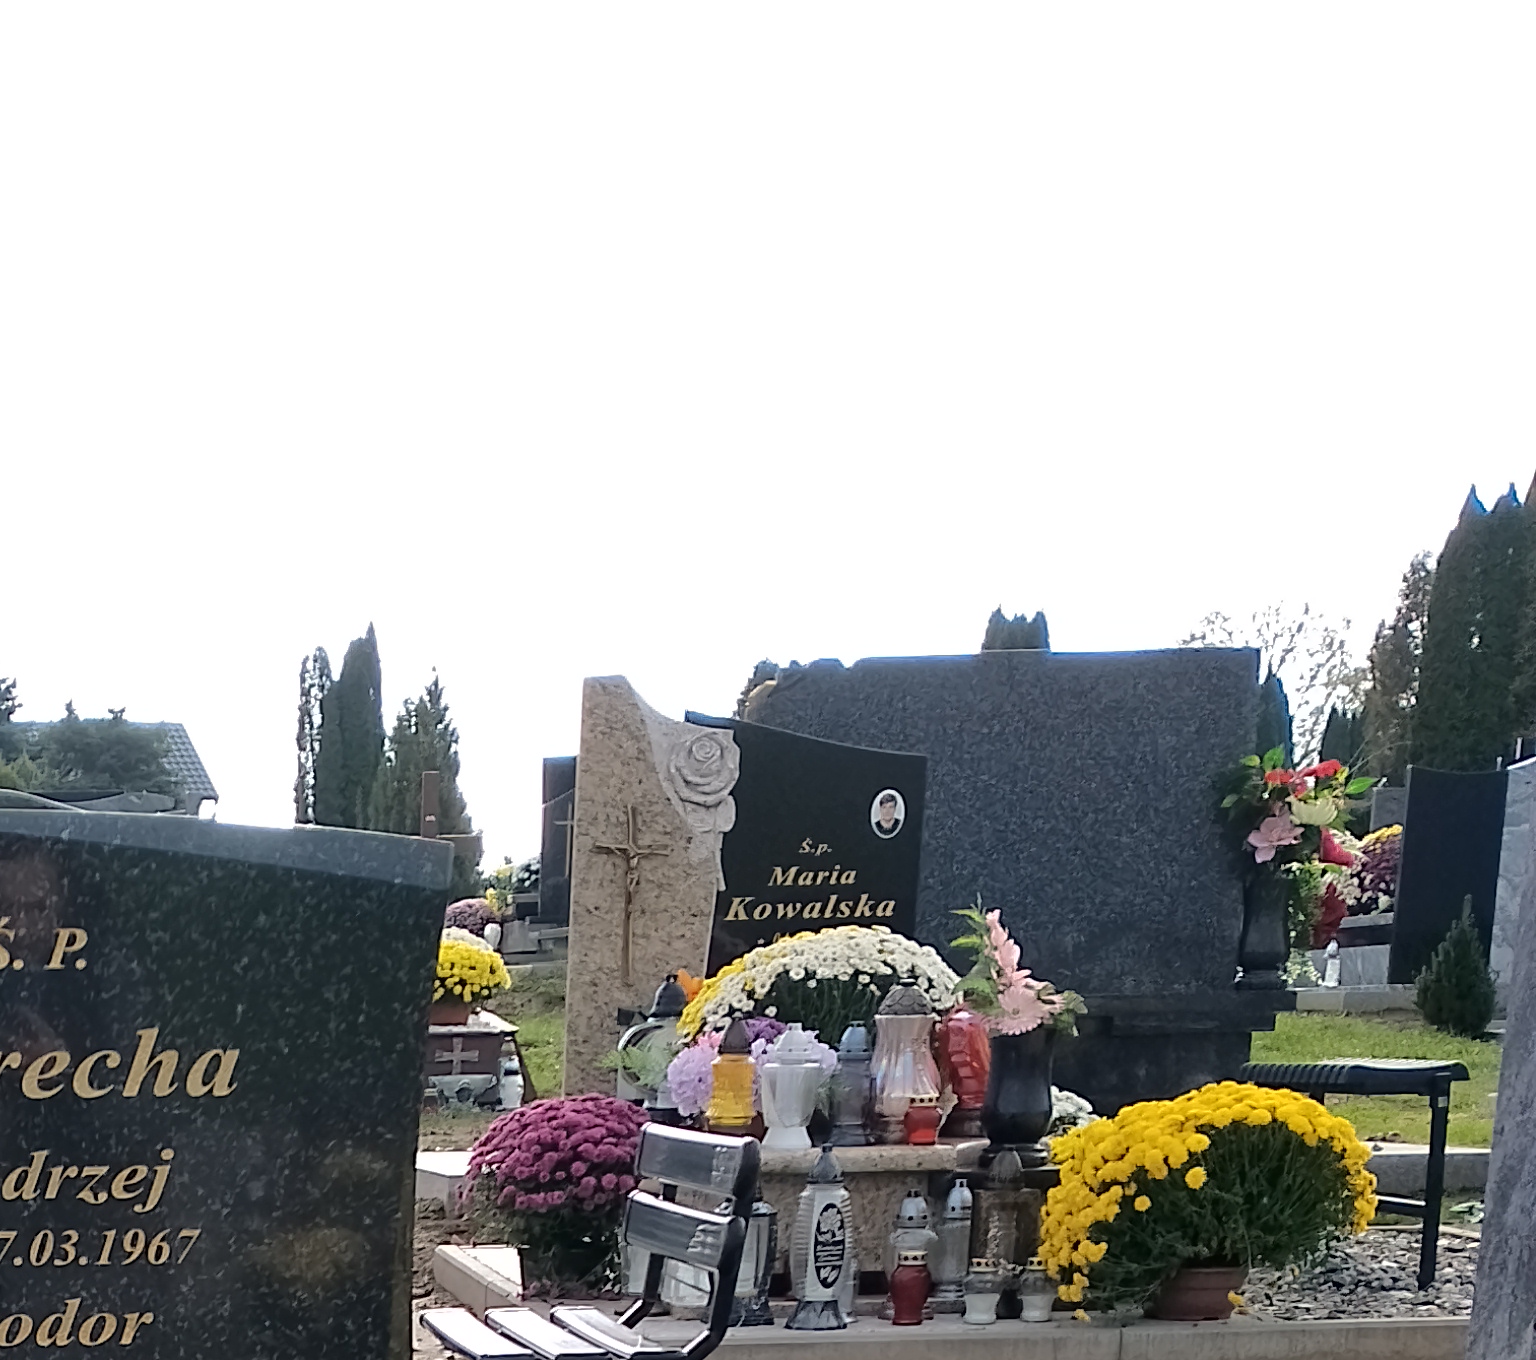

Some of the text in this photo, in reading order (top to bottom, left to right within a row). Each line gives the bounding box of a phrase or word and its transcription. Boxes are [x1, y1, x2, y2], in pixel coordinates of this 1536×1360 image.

[767, 864, 857, 887] Maria
[723, 893, 896, 921] Kowalska
[43, 927, 89, 971] P.
